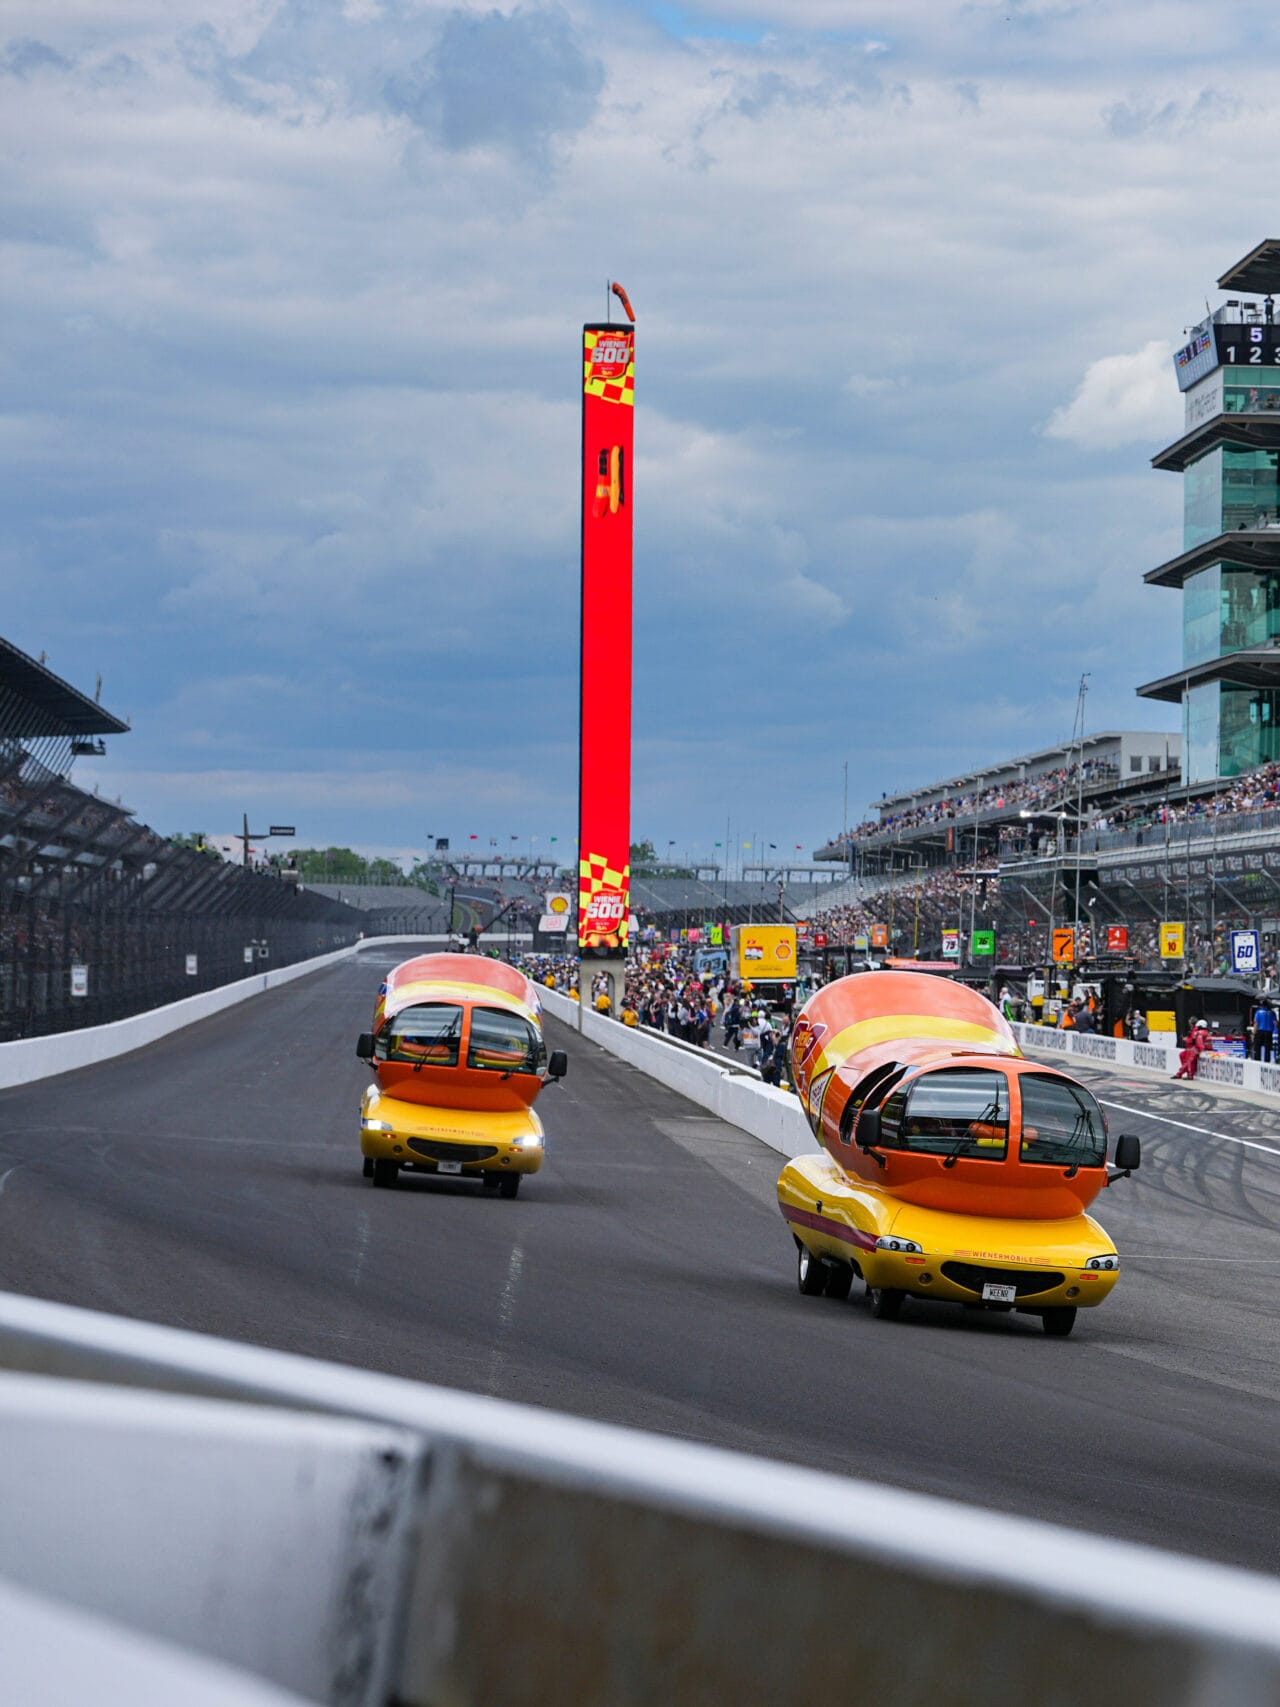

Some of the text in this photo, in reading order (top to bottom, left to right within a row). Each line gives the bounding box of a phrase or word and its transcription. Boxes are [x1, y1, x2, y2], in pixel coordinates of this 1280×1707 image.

[1250, 327, 1263, 342] 5
[591, 347, 629, 363] 500
[1226, 346, 1236, 362] 1
[1249, 346, 1262, 363] 2
[586, 903, 625, 919] 500
[1114, 930, 1121, 938] 4
[1167, 941, 1177, 951] 10
[1237, 945, 1254, 958] 60
[972, 1250, 1034, 1263] WIENERMOBILE
[989, 1288, 1009, 1298] WEENR
